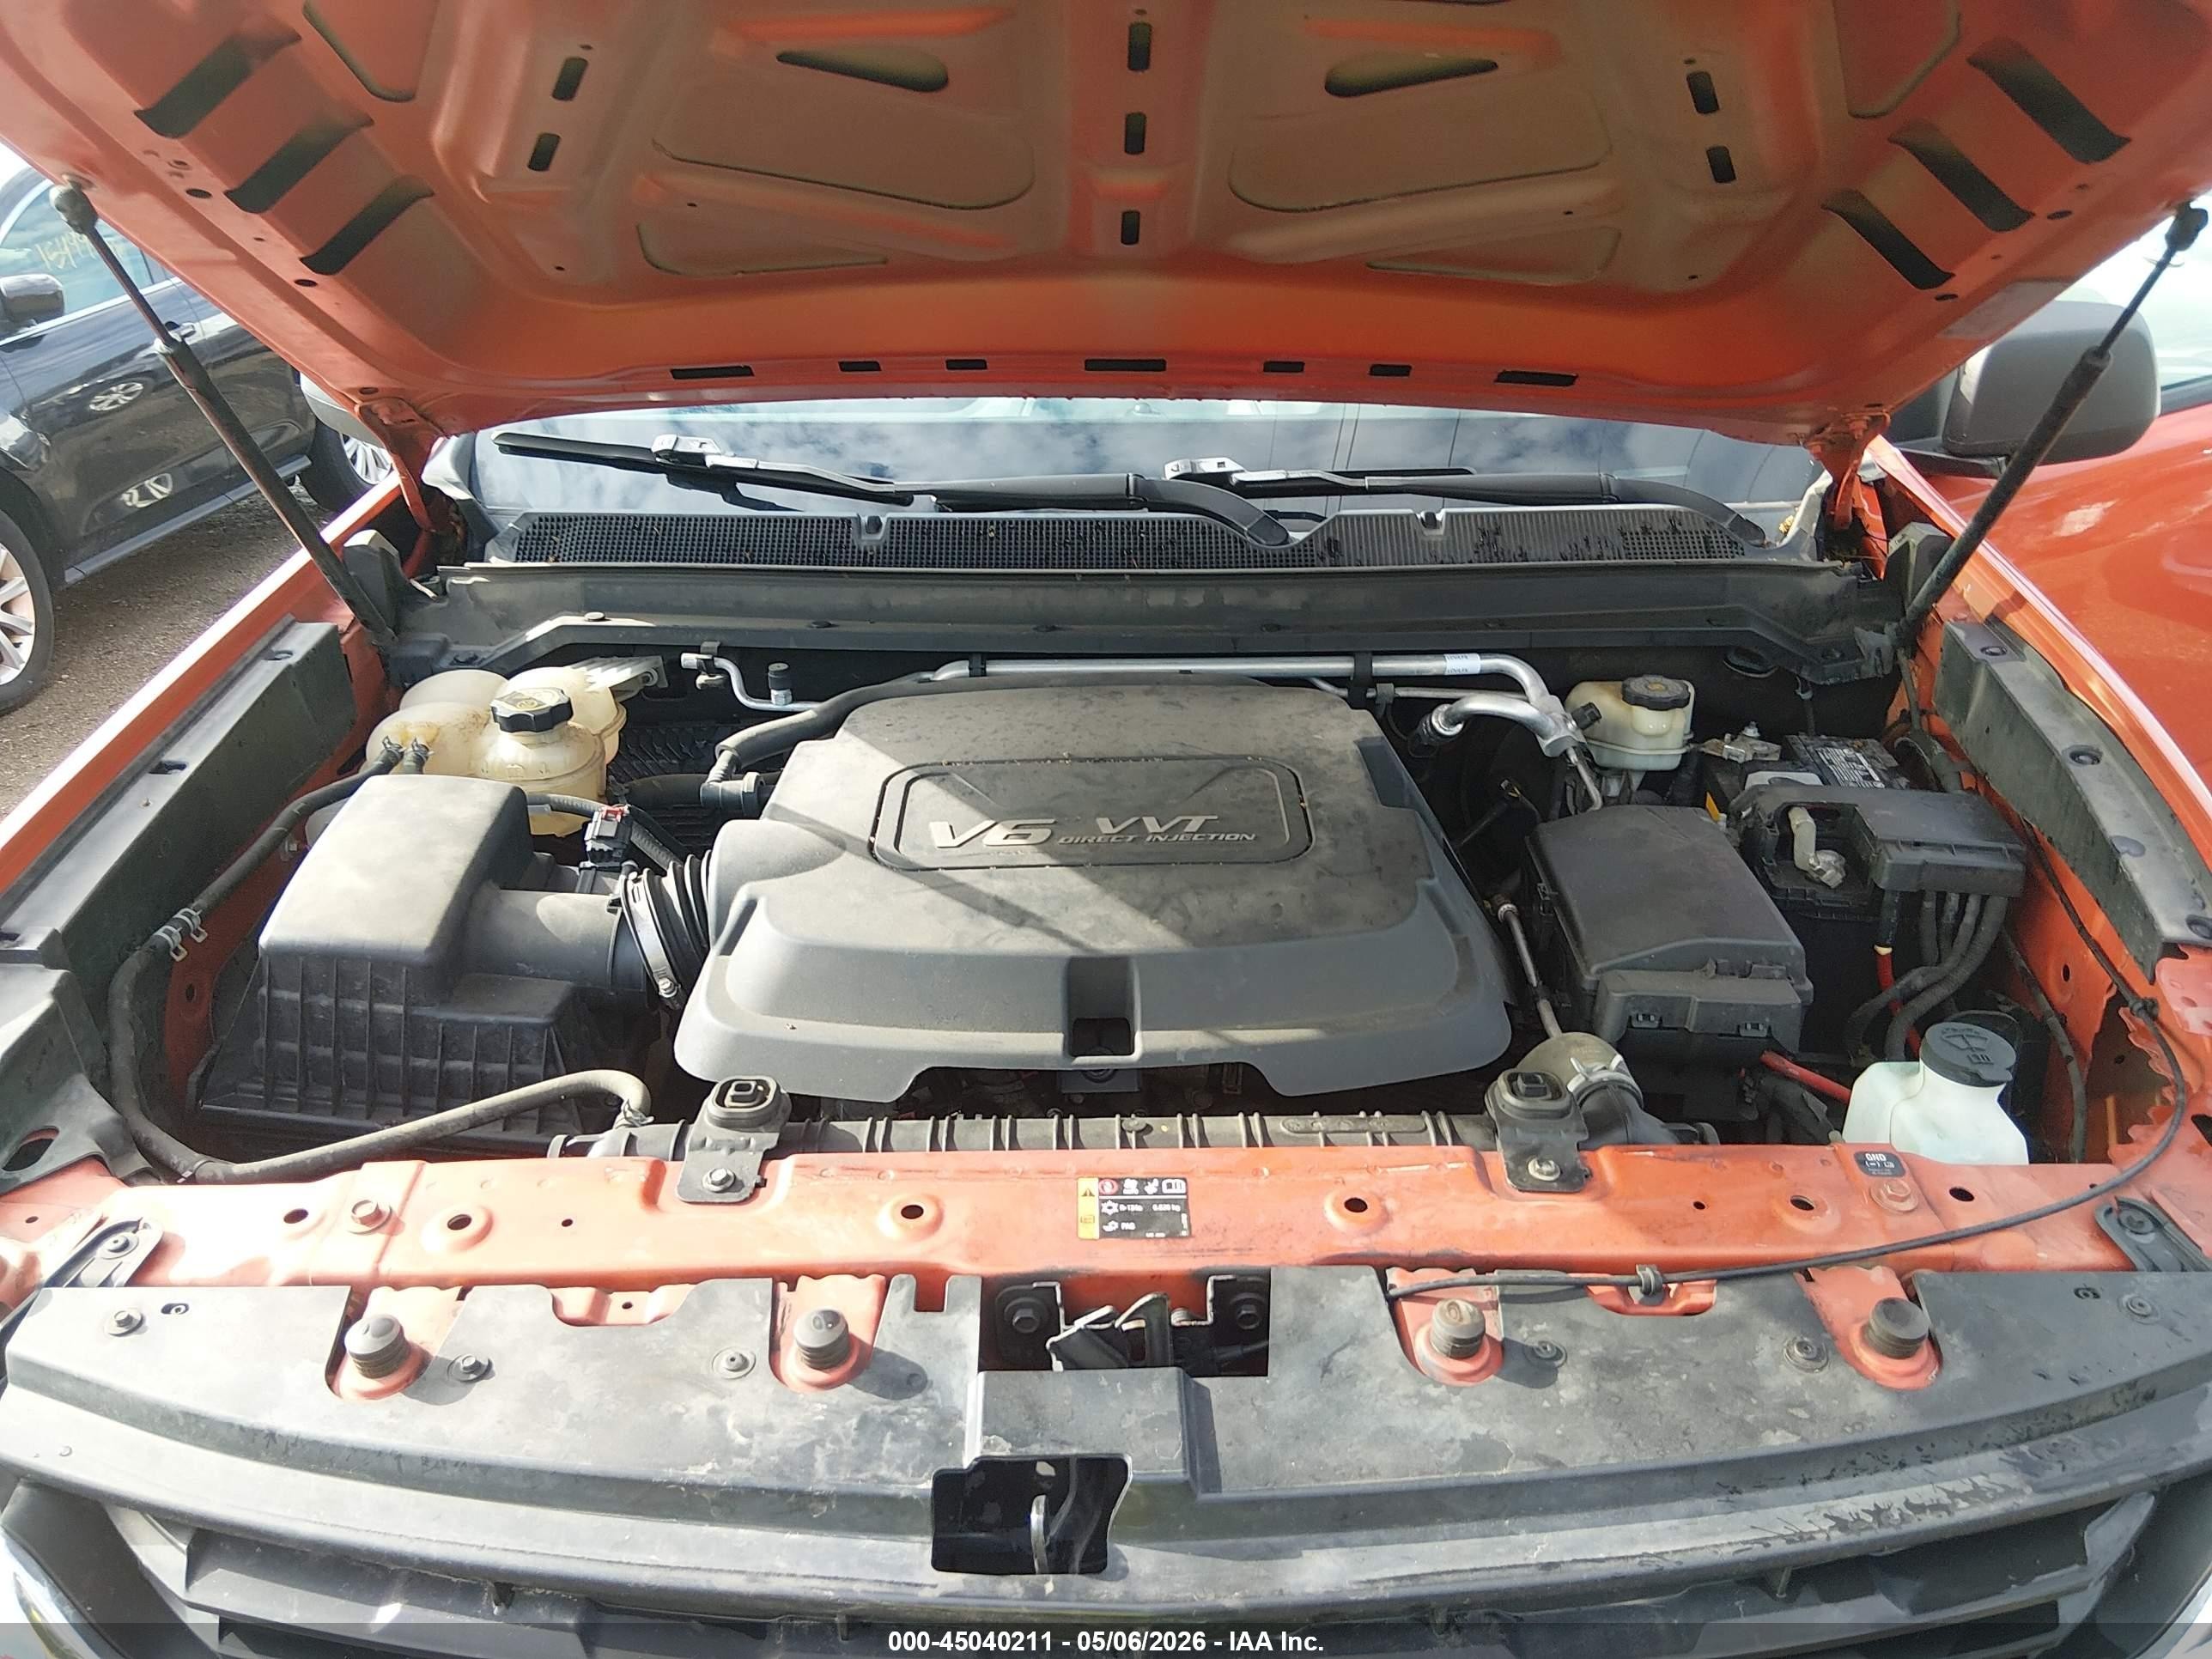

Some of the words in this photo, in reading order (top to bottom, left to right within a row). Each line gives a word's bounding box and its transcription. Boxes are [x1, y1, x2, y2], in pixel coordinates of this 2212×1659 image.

[929, 818, 1057, 849] V6
[1096, 815, 1219, 835] VVT
[1057, 833, 1139, 845] DIRECT
[1145, 832, 1256, 843] INJECTION
[1864, 1152, 1887, 1162] GND
